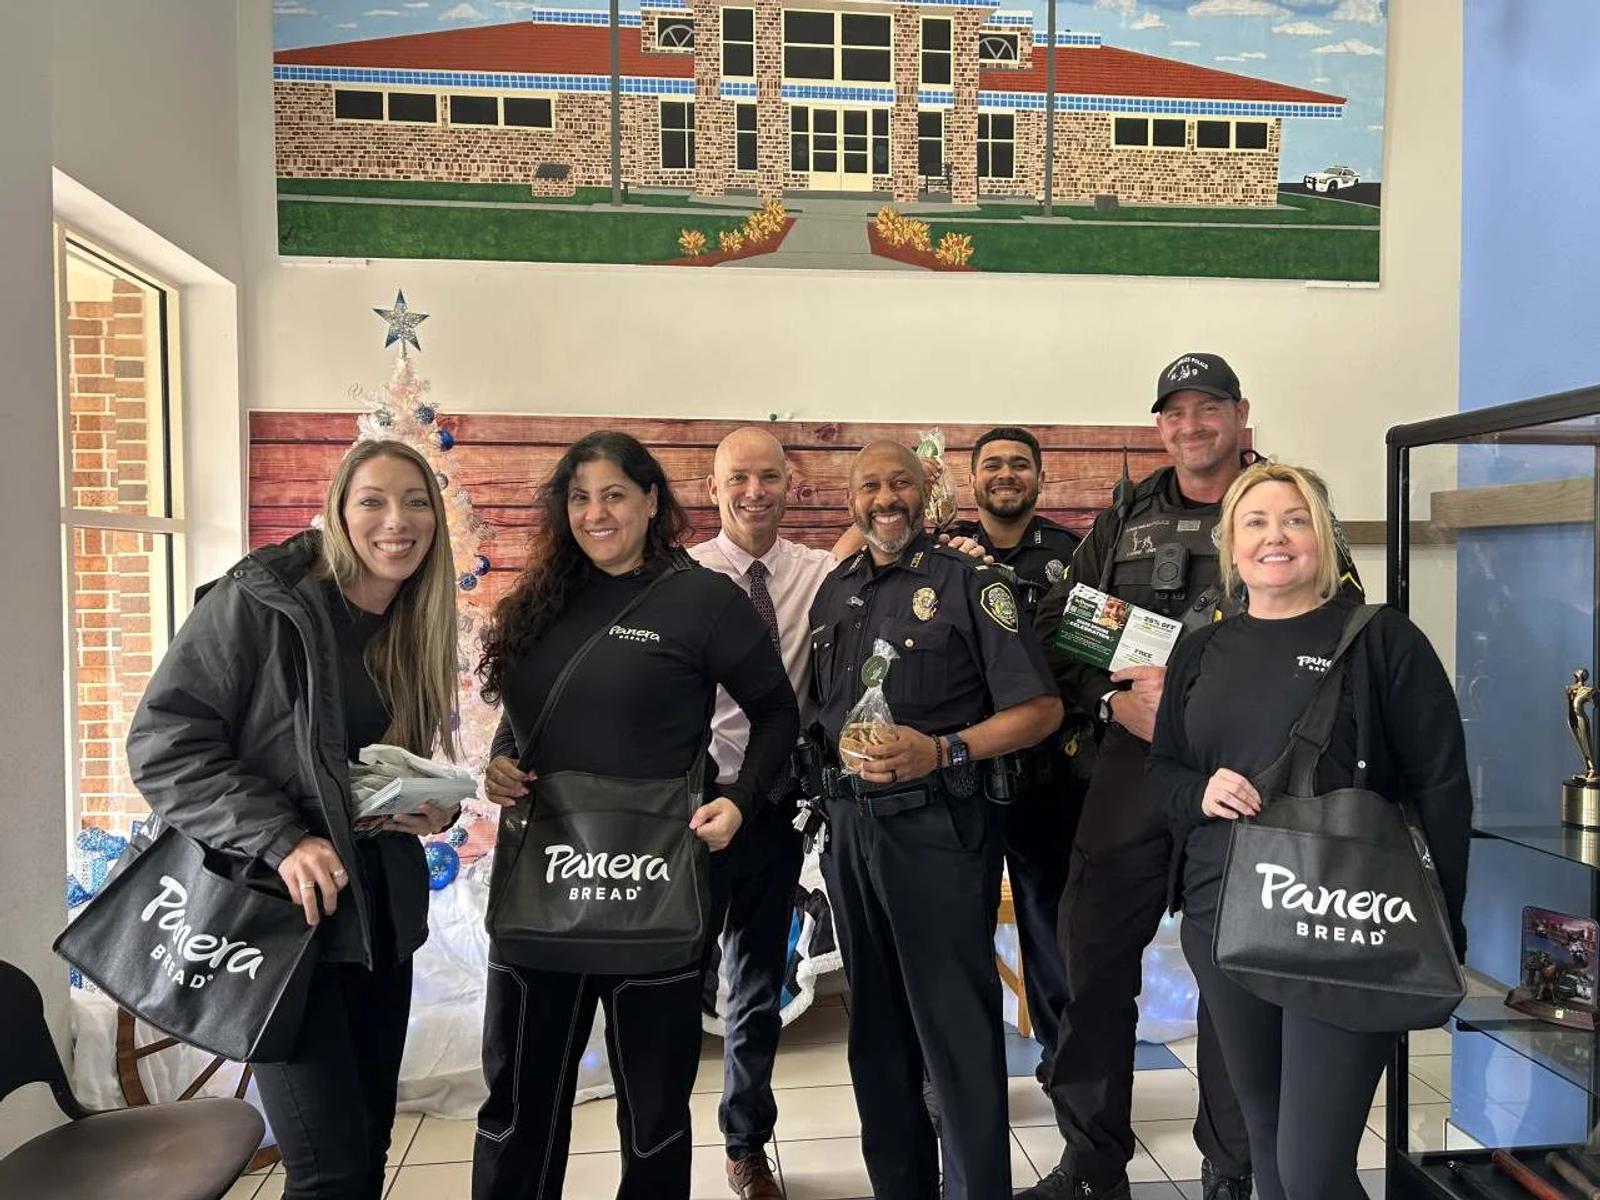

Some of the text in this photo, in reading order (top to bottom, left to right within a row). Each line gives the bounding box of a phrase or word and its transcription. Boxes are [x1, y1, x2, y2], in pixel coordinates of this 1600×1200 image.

[608, 625, 660, 642] Panera
[1134, 648, 1153, 659] FREE
[545, 844, 670, 884] Panera
[568, 887, 638, 900] BREAD
[1255, 863, 1417, 924] Panera
[141, 875, 263, 980] Panera
[1296, 921, 1385, 945] BREAD
[150, 944, 207, 988] BREAD
